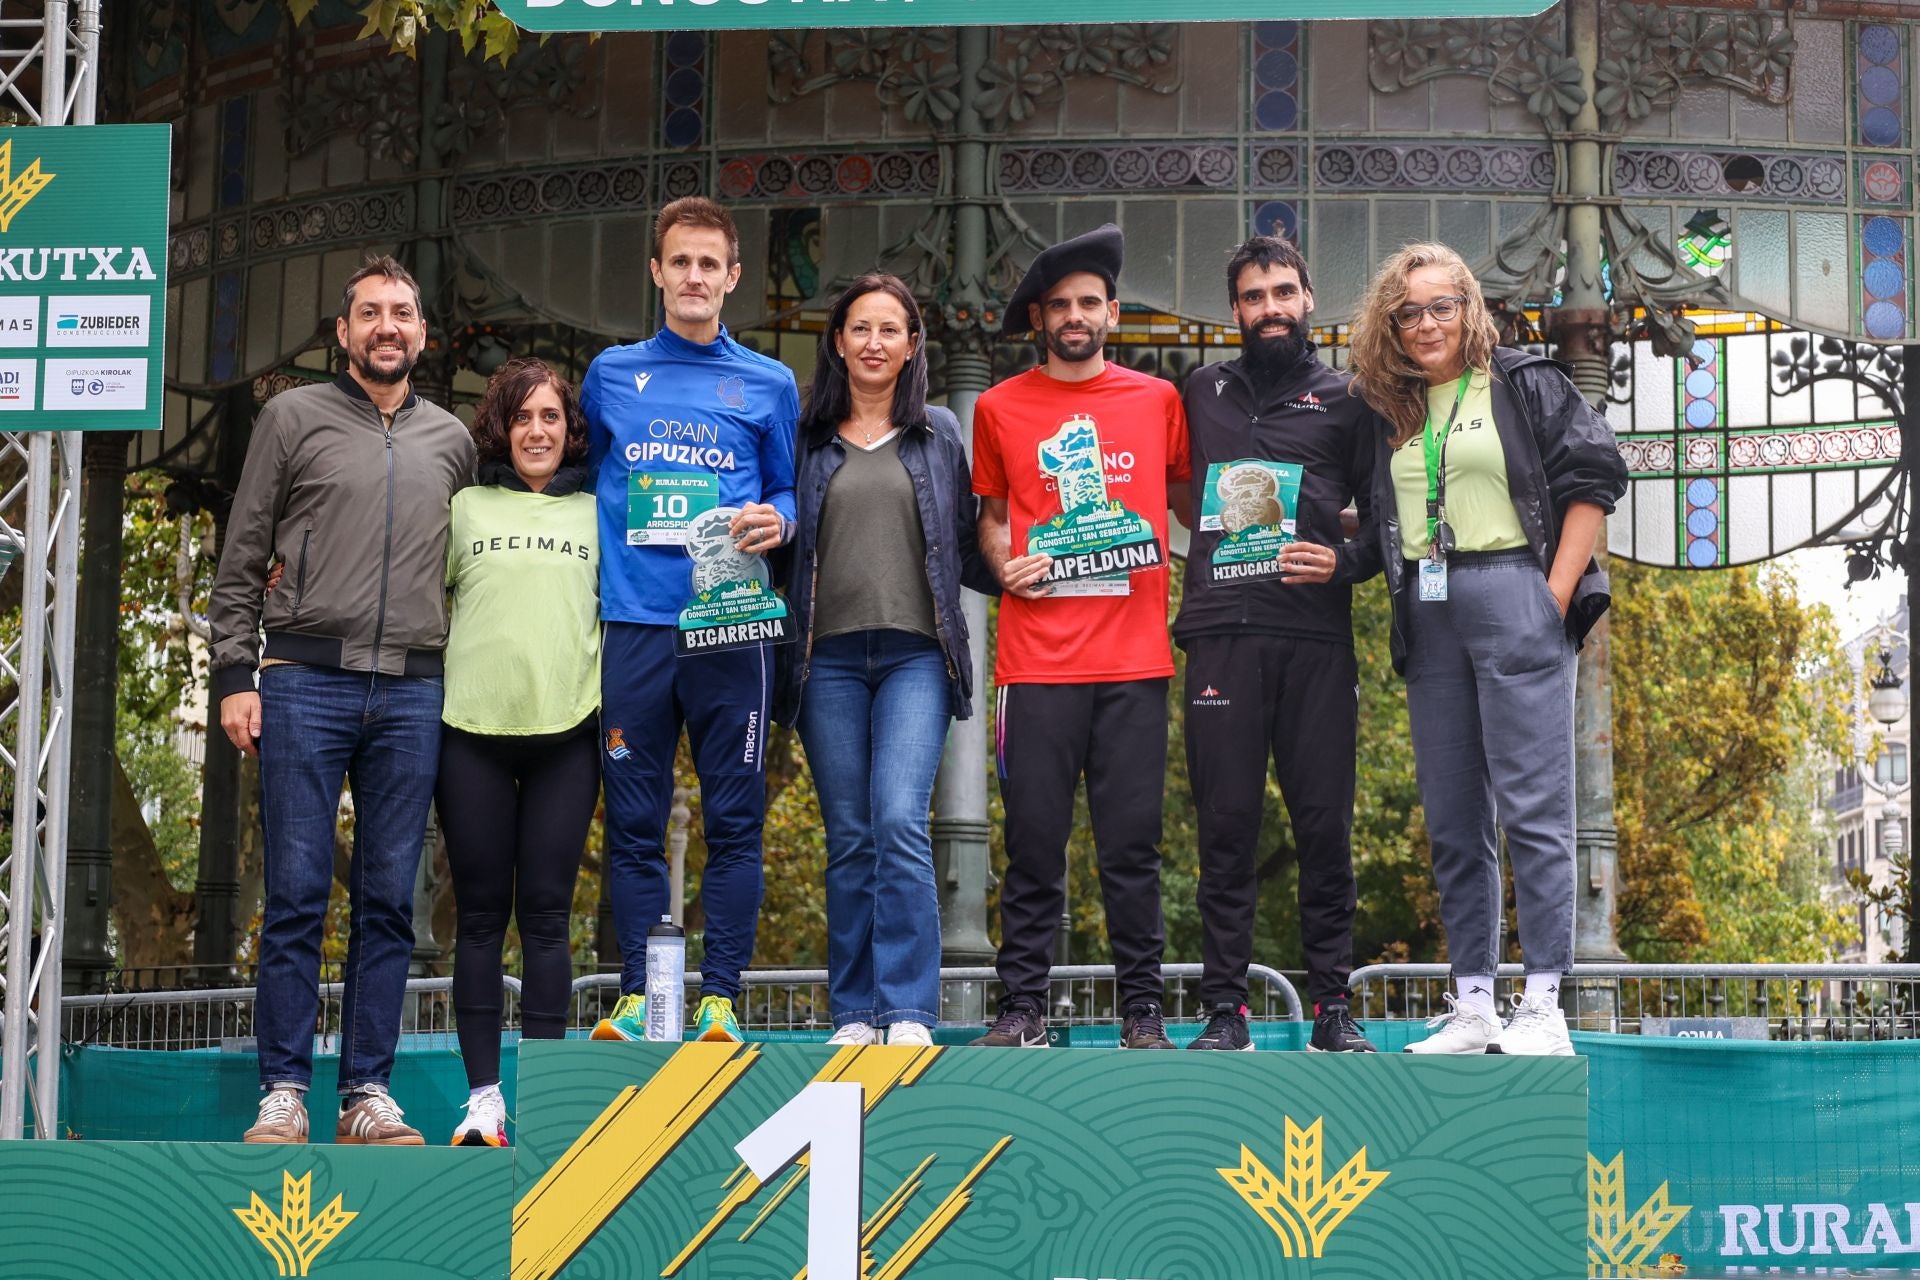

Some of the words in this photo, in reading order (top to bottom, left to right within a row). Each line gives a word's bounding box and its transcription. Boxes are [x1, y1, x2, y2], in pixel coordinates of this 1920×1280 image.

[0, 247, 156, 281] KUTXA
[80, 316, 140, 329] ZUBIEDER
[649, 419, 718, 444] ORAIN
[625, 442, 735, 470] GIPUZKOA
[681, 479, 709, 487] KUTXA
[652, 494, 688, 518] 10
[647, 520, 690, 529] ARROSPID
[1038, 536, 1075, 549] DONOSTIA
[1082, 531, 1098, 541] SAN
[1099, 524, 1140, 538] SEBASTIÁN
[473, 536, 589, 561] DECIMAS
[688, 609, 720, 619] DONOSTIA
[725, 606, 739, 614] SAN
[740, 601, 775, 612] SEBASTIÁN
[685, 619, 784, 648] BIGARRENA
[743, 711, 758, 763] macron
[651, 993, 666, 1040] 226ERS
[734, 1081, 862, 1280] 1
